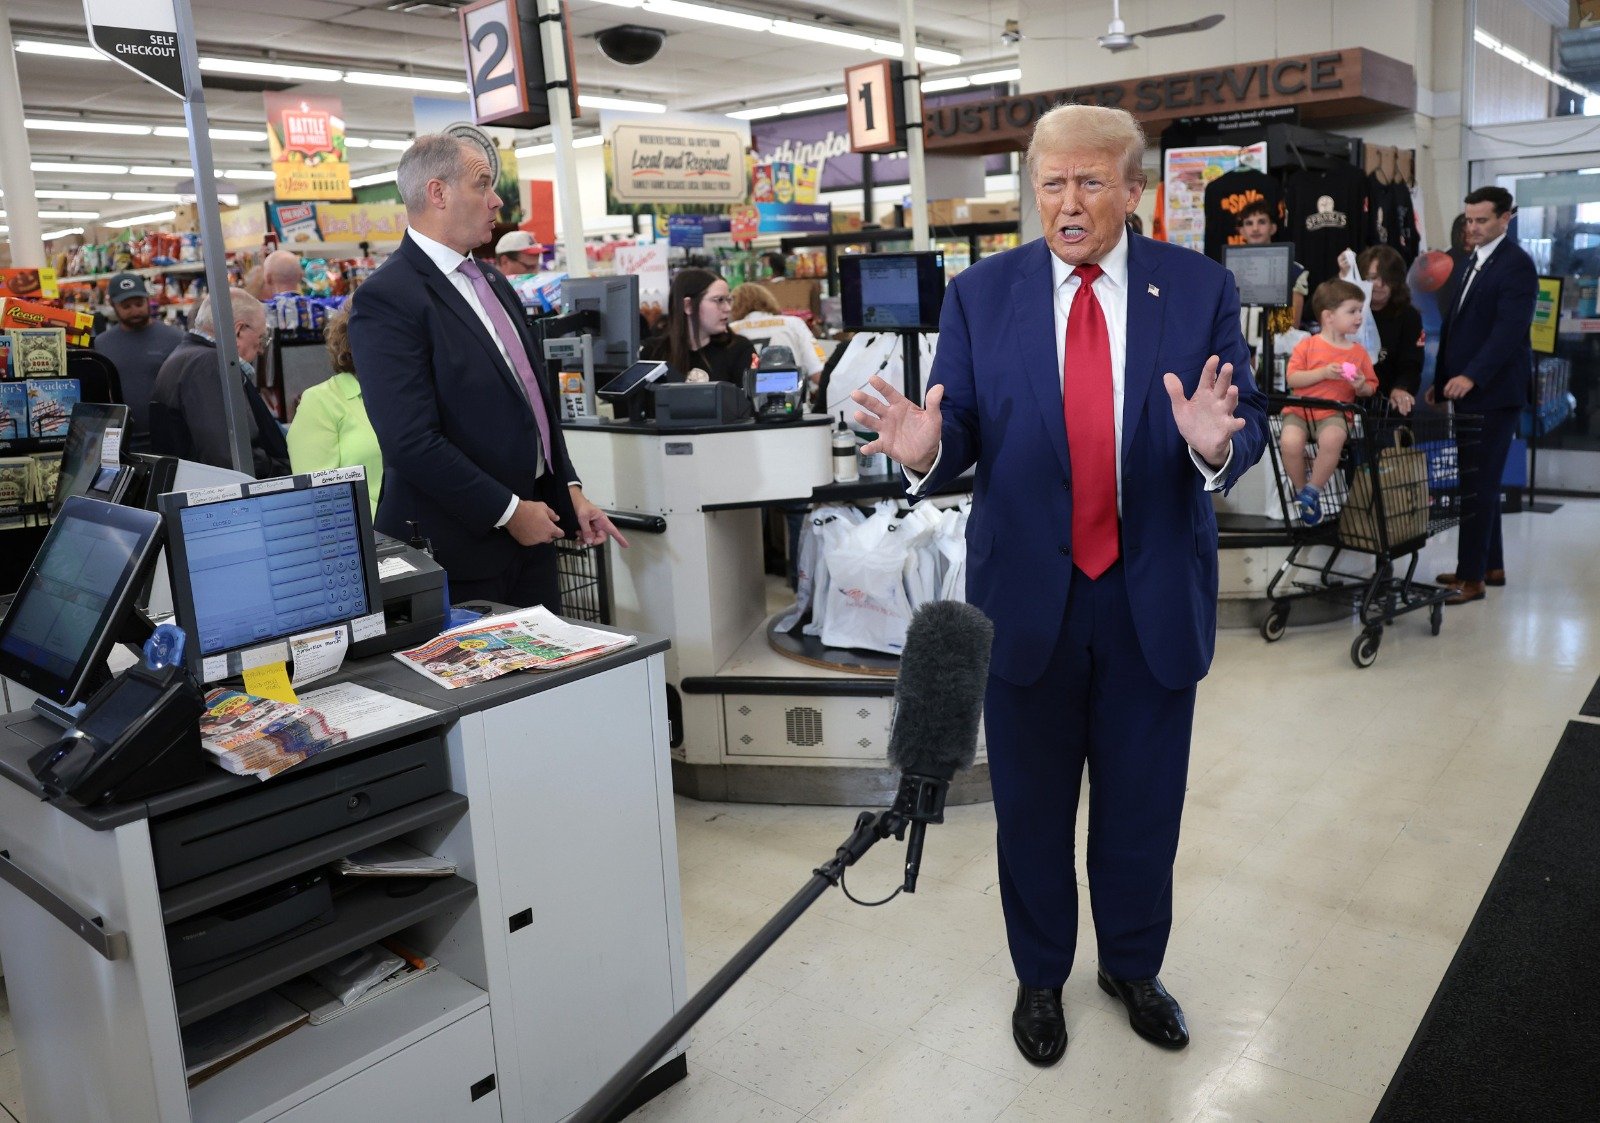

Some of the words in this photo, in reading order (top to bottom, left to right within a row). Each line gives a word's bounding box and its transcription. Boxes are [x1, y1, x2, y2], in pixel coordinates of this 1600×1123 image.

[115, 43, 176, 57] CHECKOUT
[149, 34, 174, 46] SELF
[470, 21, 517, 99] 2
[1135, 52, 1344, 113] SERVICE
[858, 82, 875, 131] 1
[631, 149, 664, 170] Local
[663, 151, 684, 170] and
[684, 150, 731, 175] Regional
[7, 306, 45, 323] Reese's
[344, 471, 362, 480] Coffee
